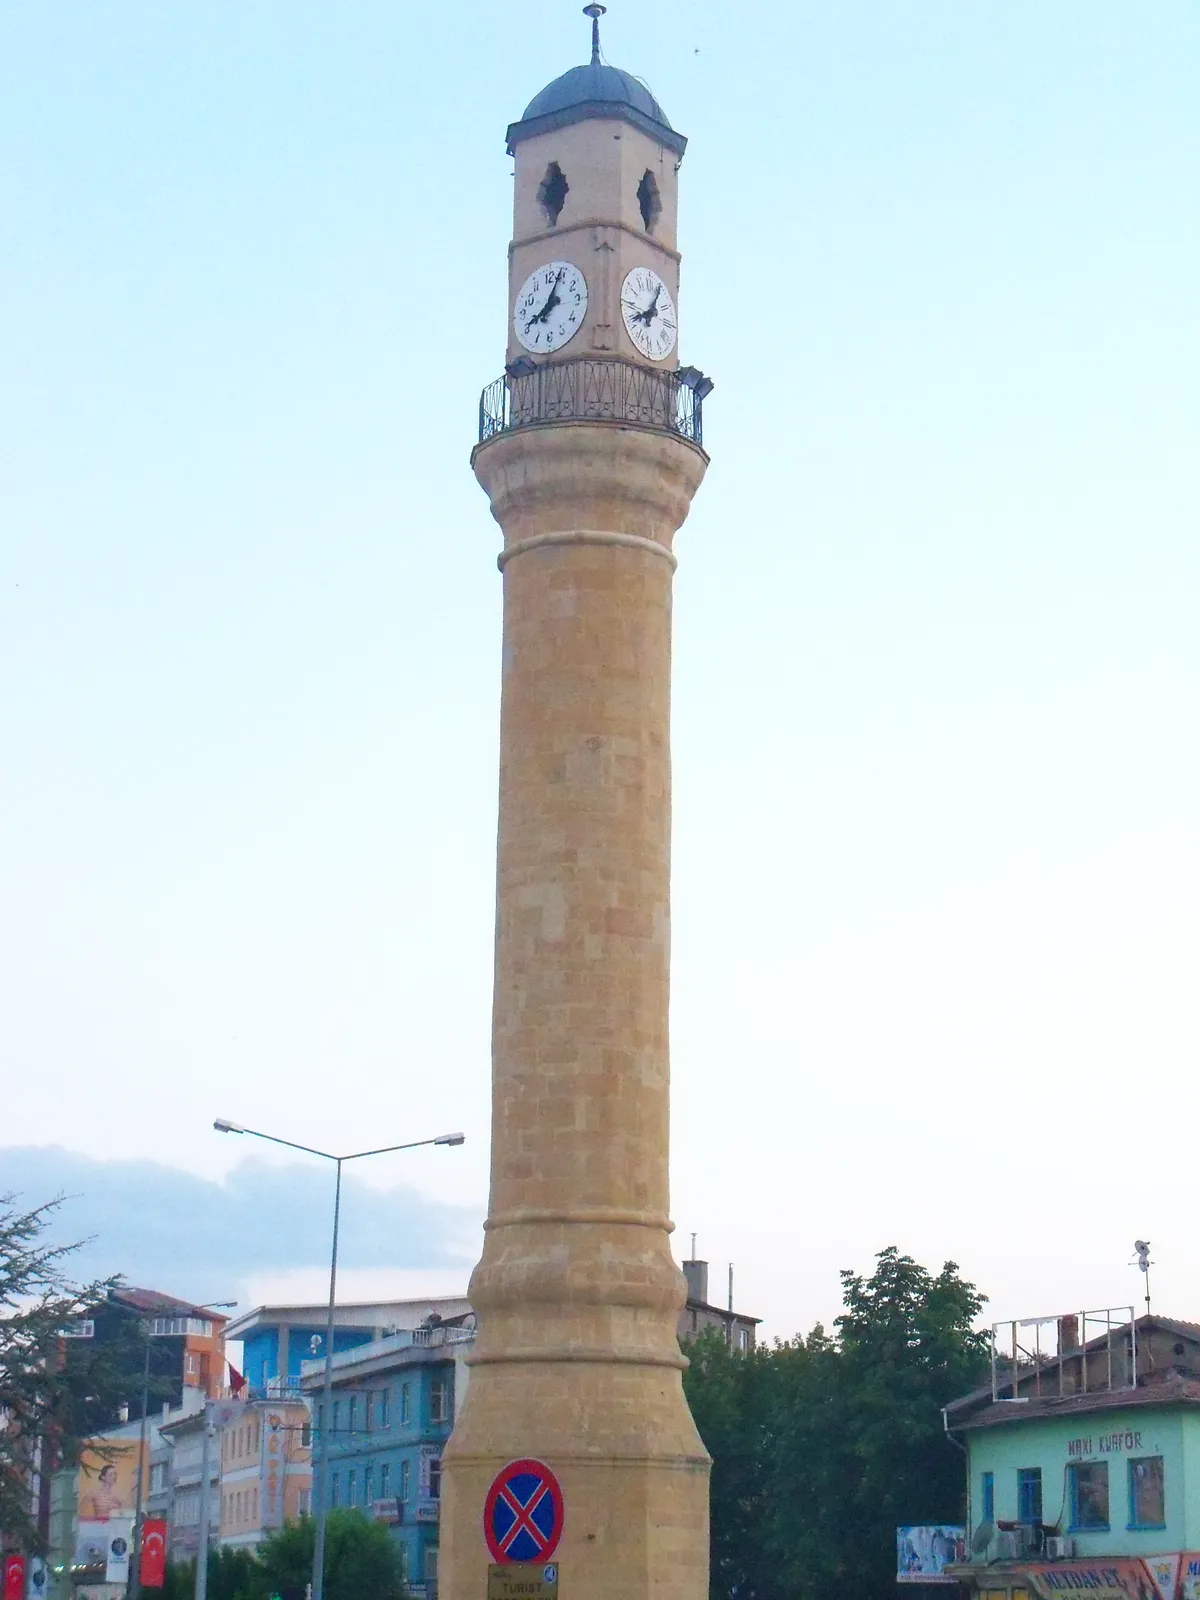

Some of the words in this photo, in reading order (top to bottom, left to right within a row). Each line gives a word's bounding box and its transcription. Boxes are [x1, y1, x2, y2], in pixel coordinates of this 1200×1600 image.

[545, 270, 555, 284] 12
[569, 280, 576, 292] 2
[524, 293, 534, 307] 10
[568, 310, 576, 322] 4
[559, 322, 565, 335] 5
[546, 331, 553, 342] 6
